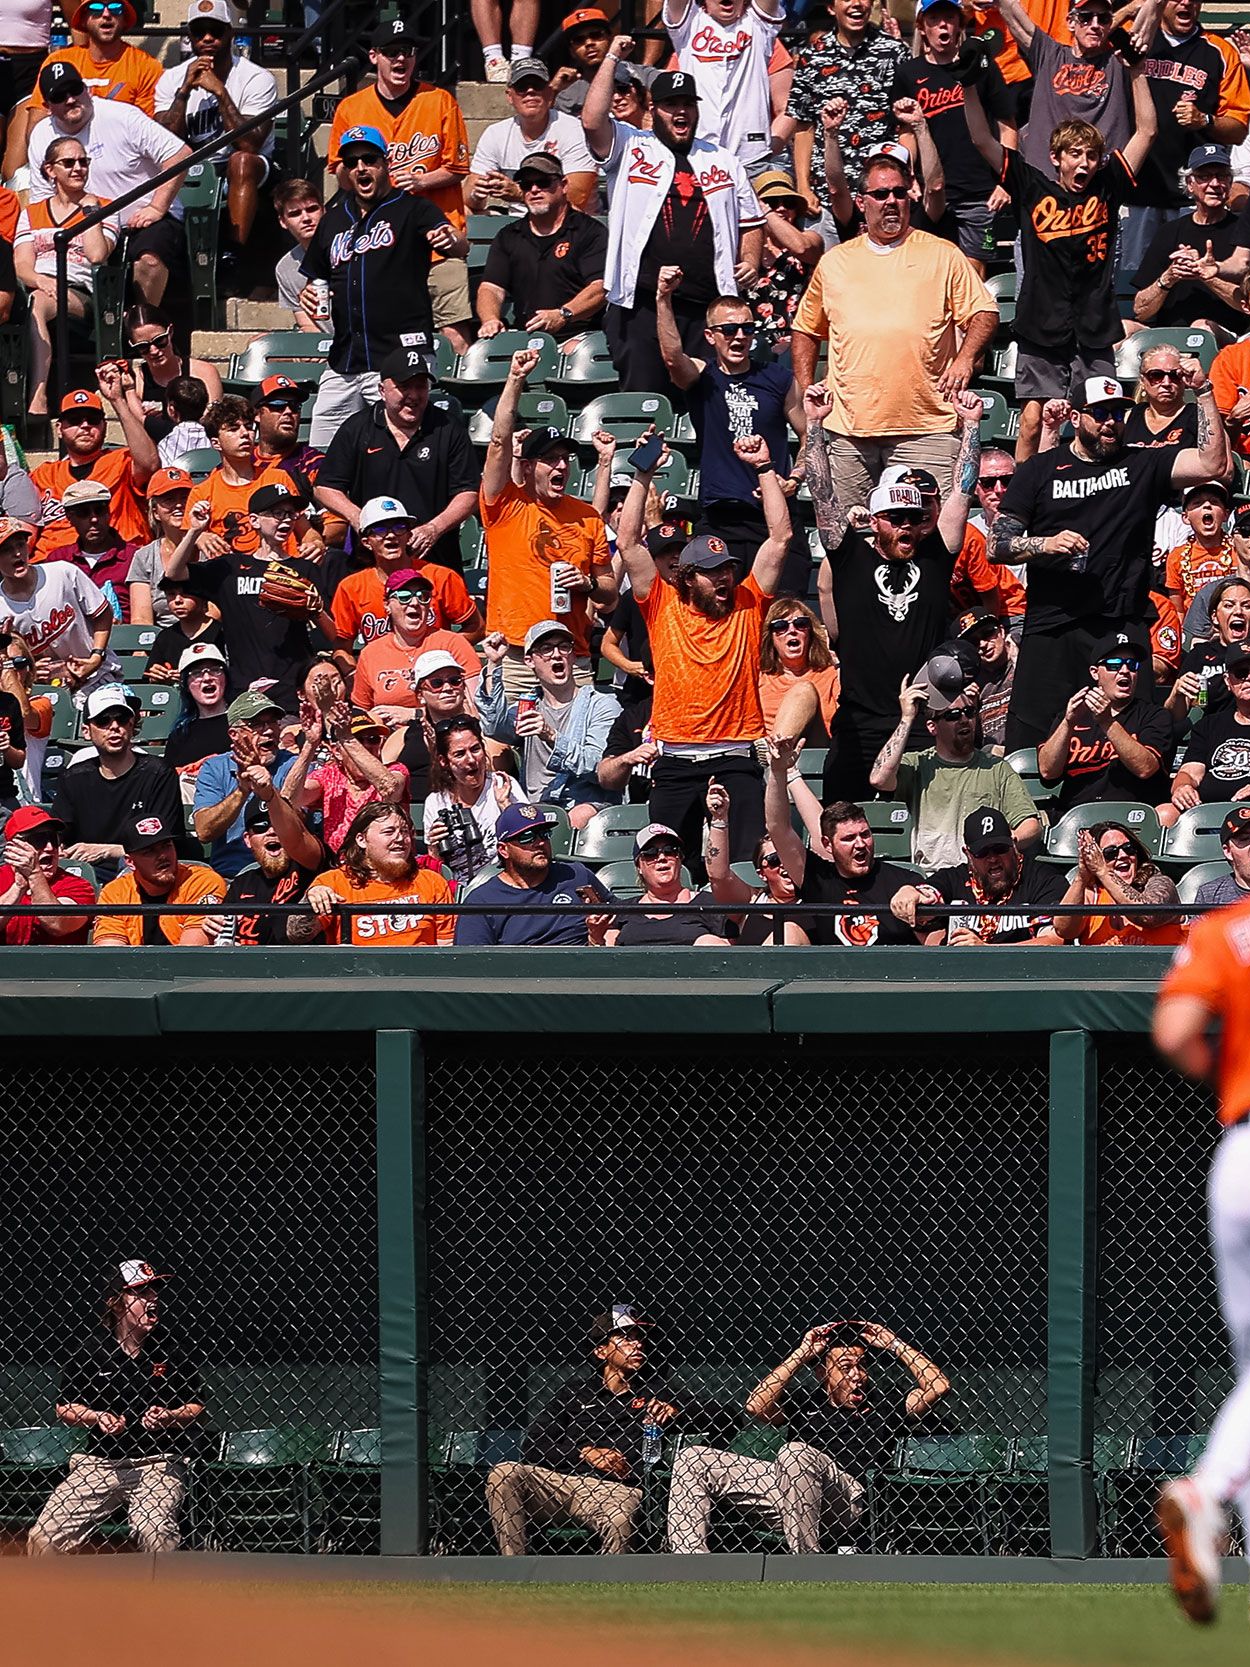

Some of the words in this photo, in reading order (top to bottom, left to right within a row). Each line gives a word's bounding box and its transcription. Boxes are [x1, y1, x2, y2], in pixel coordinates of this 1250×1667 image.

[392, 20, 405, 34] B
[52, 63, 65, 80] B
[1144, 58, 1208, 90] RIOLES
[672, 73, 685, 89] B
[331, 219, 395, 269] Mets
[1086, 233, 1108, 263] 35
[407, 351, 420, 367] B
[547, 426, 560, 439] B
[274, 483, 288, 496] B
[665, 495, 678, 511] B
[1116, 633, 1129, 644] B
[981, 816, 994, 836] B
